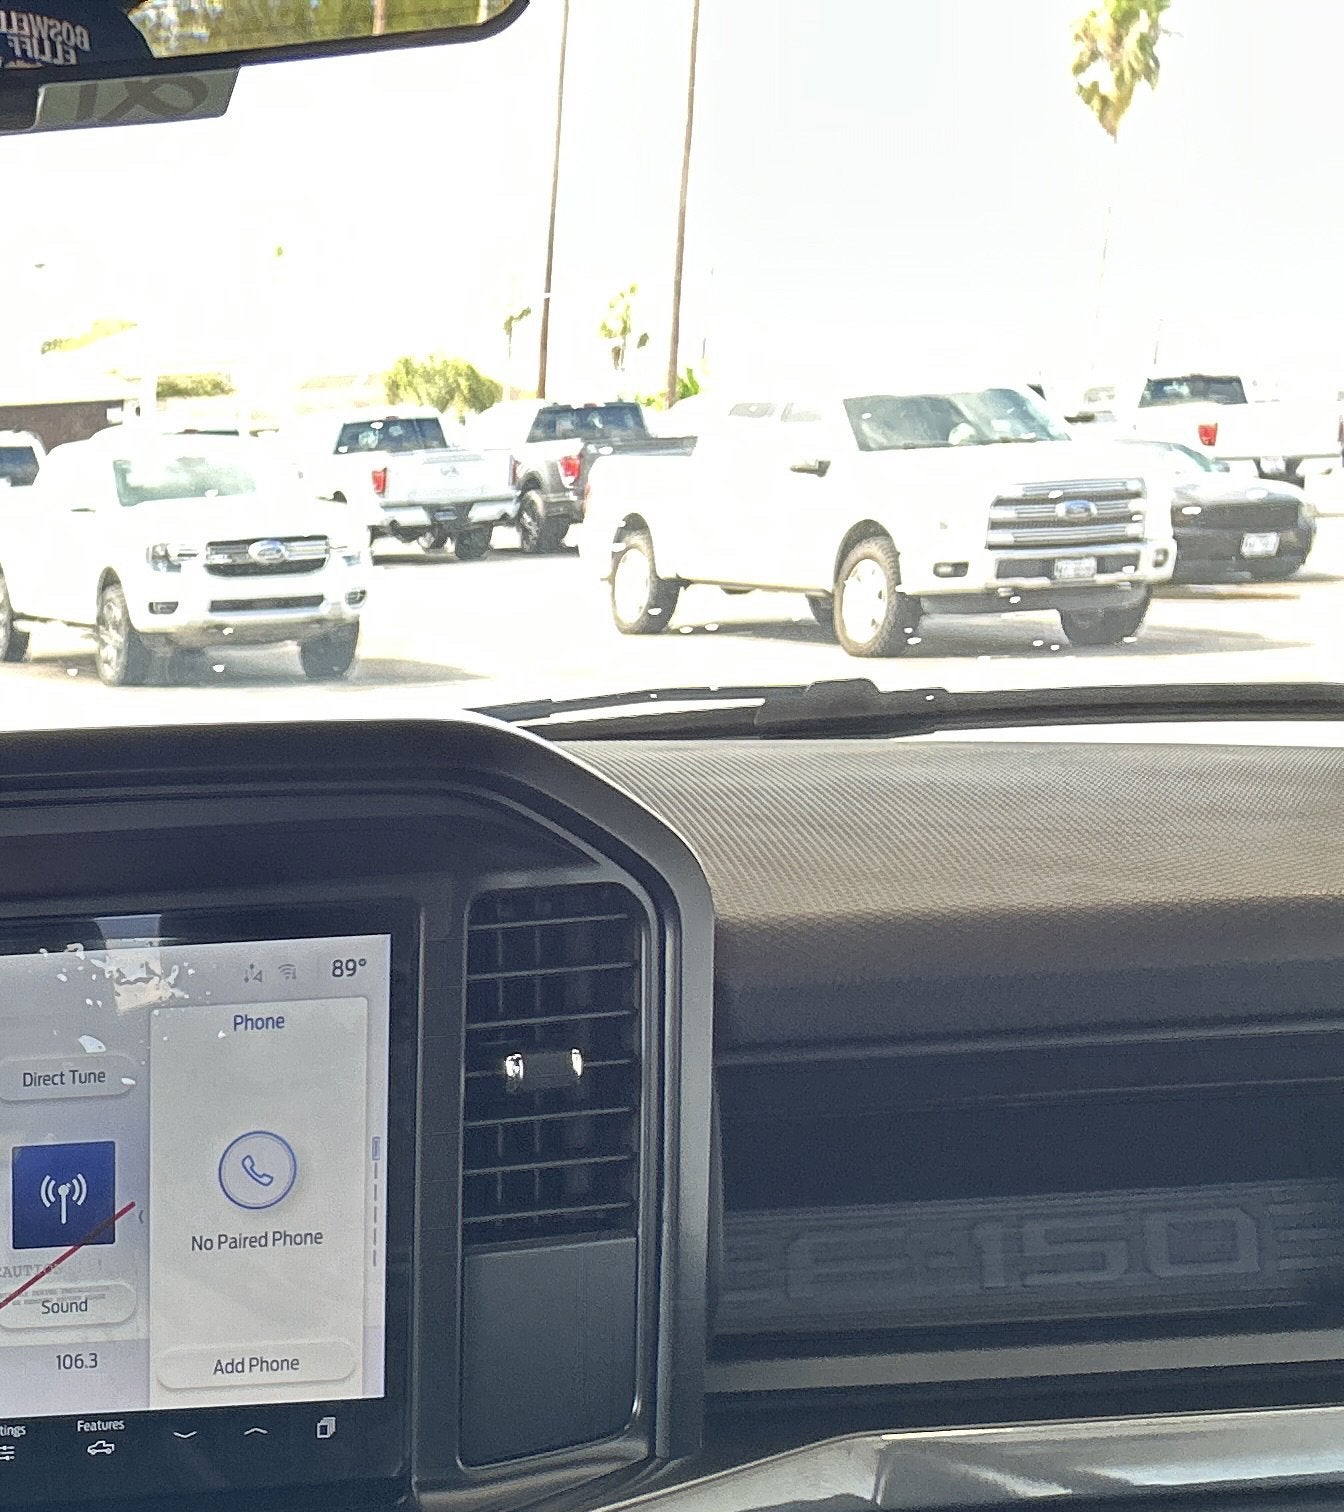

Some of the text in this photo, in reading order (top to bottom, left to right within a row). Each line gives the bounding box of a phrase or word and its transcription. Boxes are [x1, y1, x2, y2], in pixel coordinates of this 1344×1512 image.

[331, 958, 368, 978] 89°
[233, 1013, 286, 1032] Phone
[22, 1068, 106, 1088] Direct Tune
[191, 1229, 324, 1252] No Paired Phone
[41, 1299, 88, 1314] Sound
[56, 1353, 98, 1370] 106.3
[213, 1355, 300, 1375] Add Phone
[77, 1417, 125, 1432] Features
